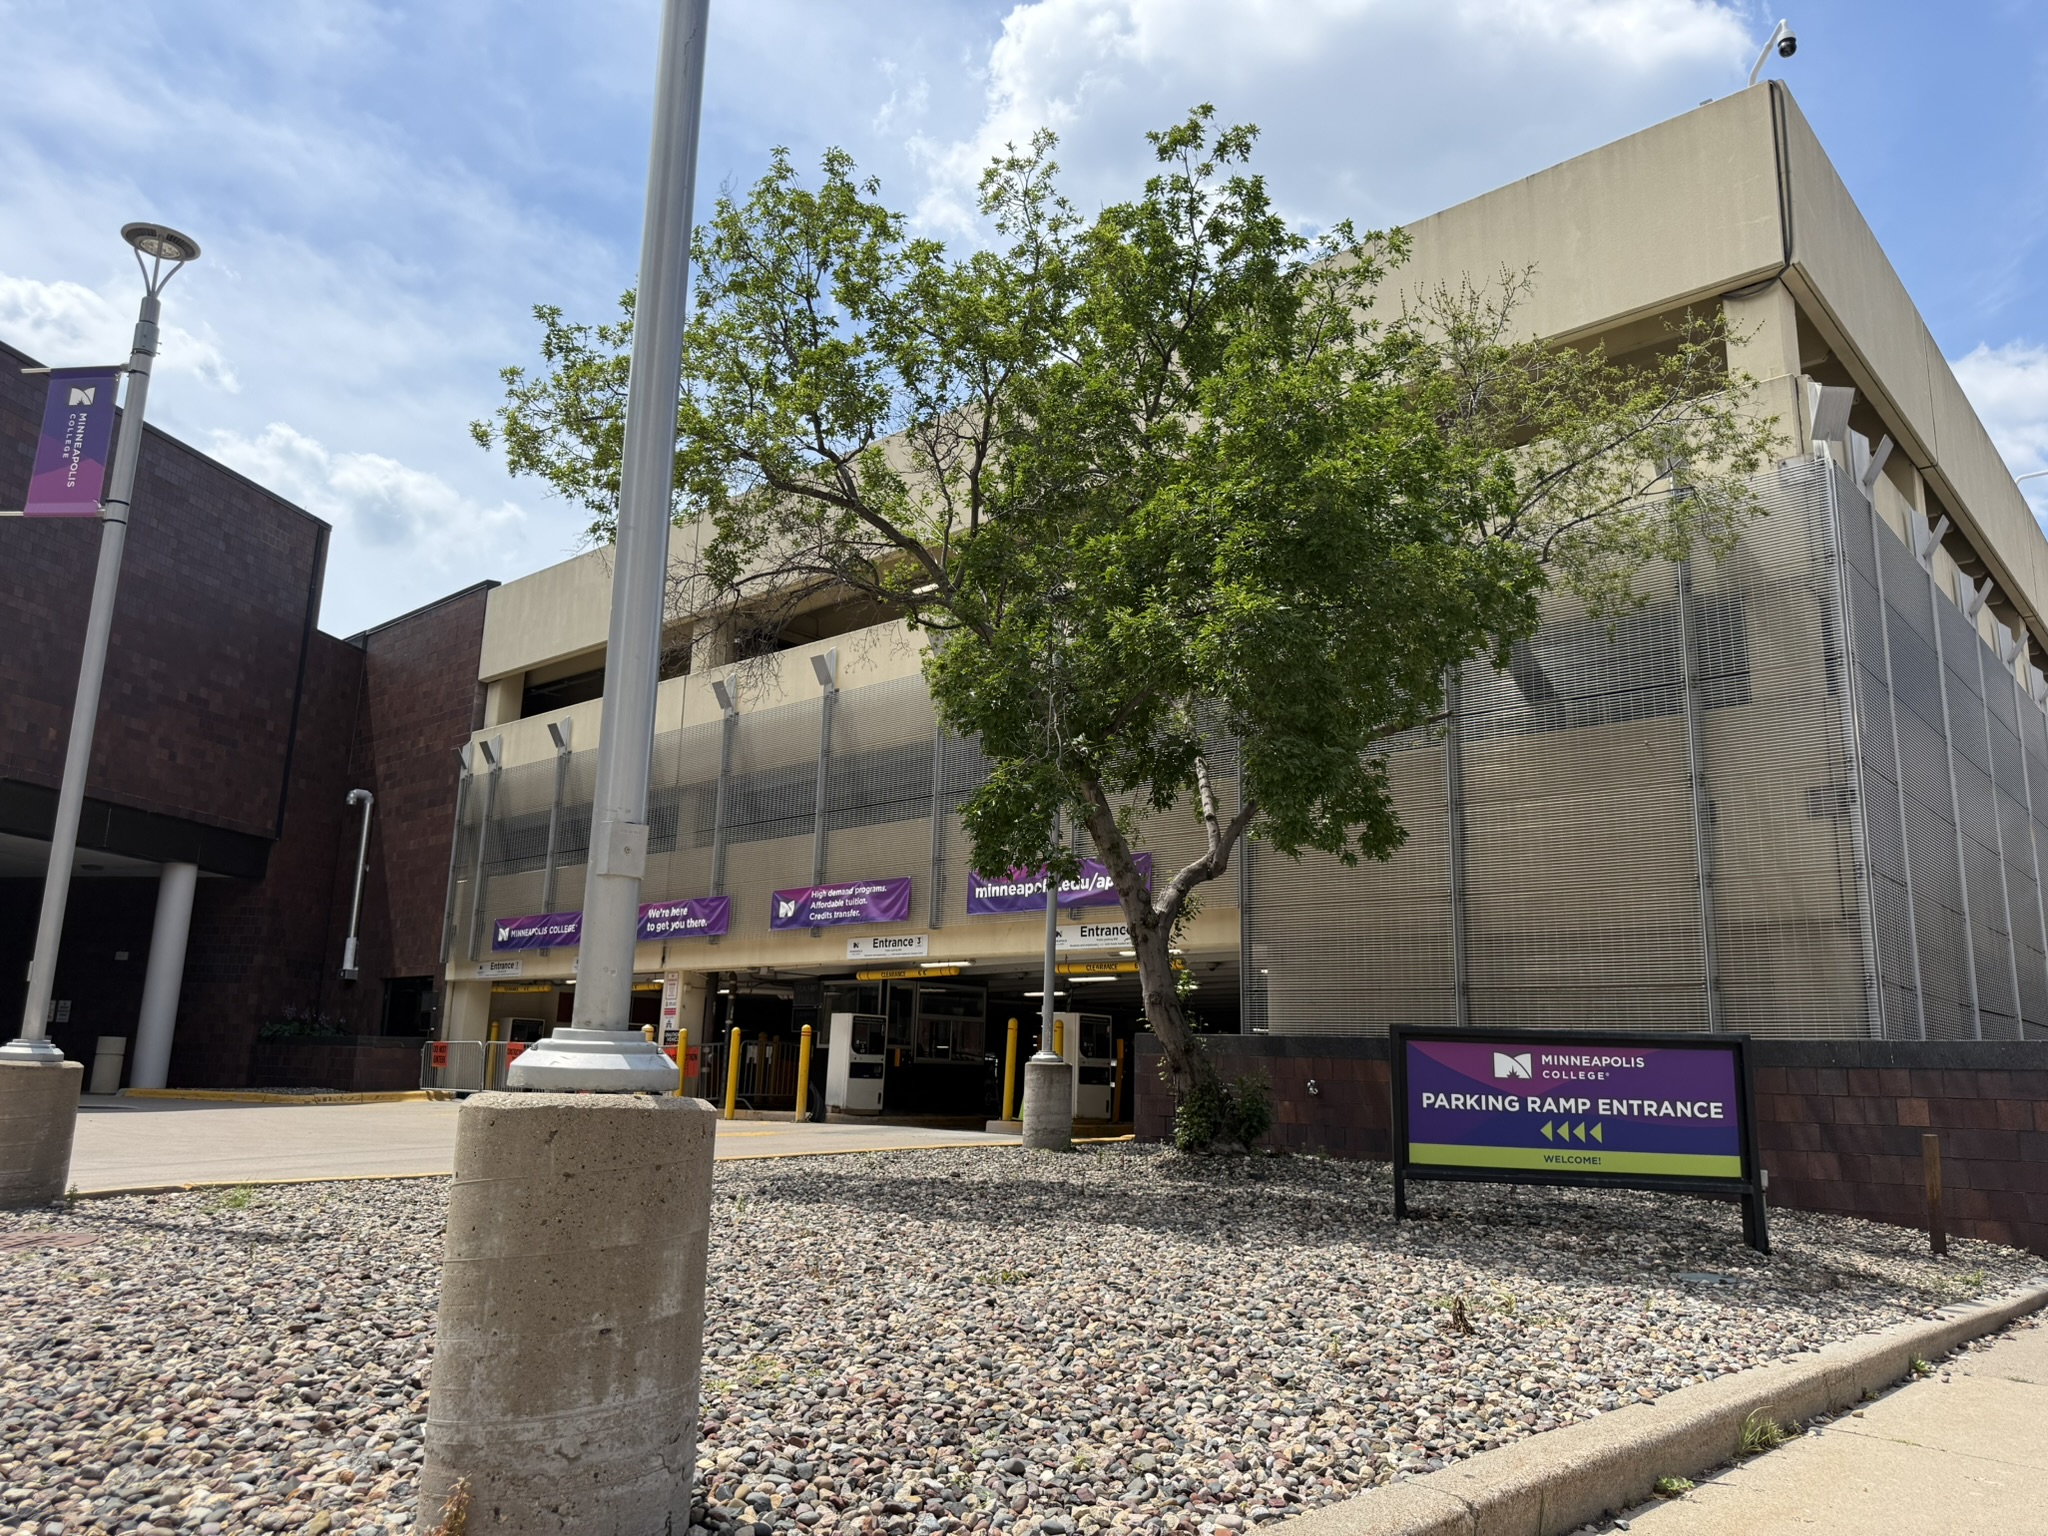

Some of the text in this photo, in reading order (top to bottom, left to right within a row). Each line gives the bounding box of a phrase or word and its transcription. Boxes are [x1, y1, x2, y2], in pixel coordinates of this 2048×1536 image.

[62, 413, 76, 459] COLLEGE
[67, 412, 88, 488] MINNEAPOLIS
[811, 885, 887, 899] High demand programs.
[810, 897, 868, 909] Affordable tuition.
[648, 906, 688, 919] We're here
[809, 909, 861, 921] Credits transfer.
[647, 918, 708, 933] to get you there.
[511, 926, 547, 938] MINNEAPOLIS
[872, 937, 921, 949] Entrance 3
[490, 961, 515, 971] Entrance
[1086, 963, 1118, 971] CLEARANCE
[881, 970, 905, 978] CLEARANCE
[1541, 1054, 1646, 1069] MINNEAPOLIS
[1421, 1091, 1725, 1120] PARKING RAMP ENTRANCE
[1543, 1154, 1602, 1166] WELCOME!
